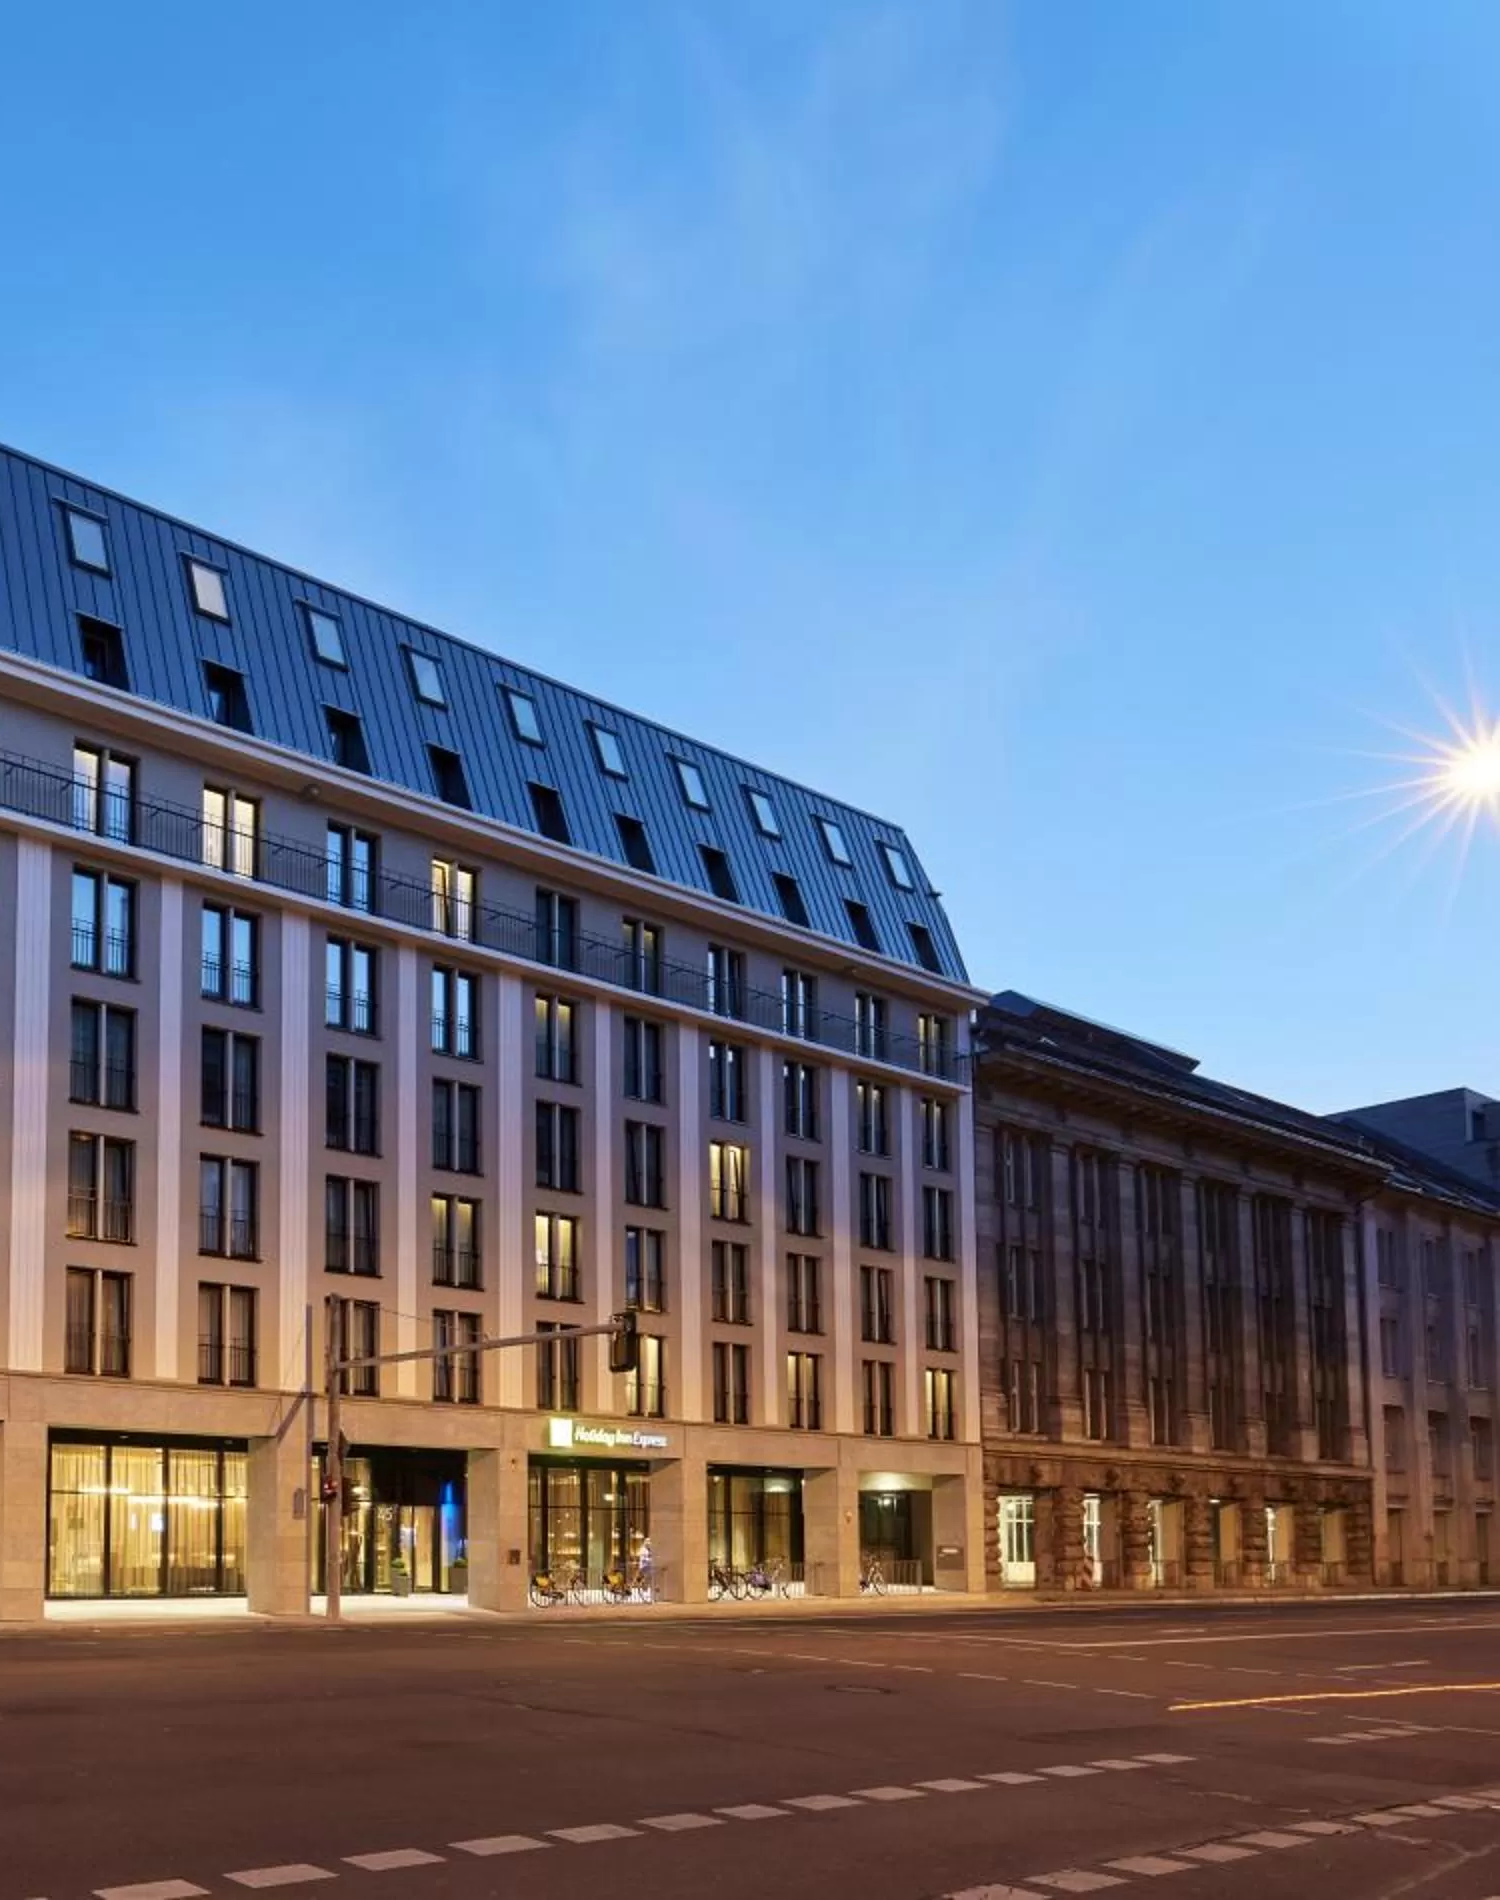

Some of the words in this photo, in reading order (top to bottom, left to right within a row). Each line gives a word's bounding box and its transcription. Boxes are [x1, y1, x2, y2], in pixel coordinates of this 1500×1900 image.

[574, 1427, 615, 1447] Holiday
[616, 1429, 632, 1444] Inn
[377, 1507, 393, 1521] 45
